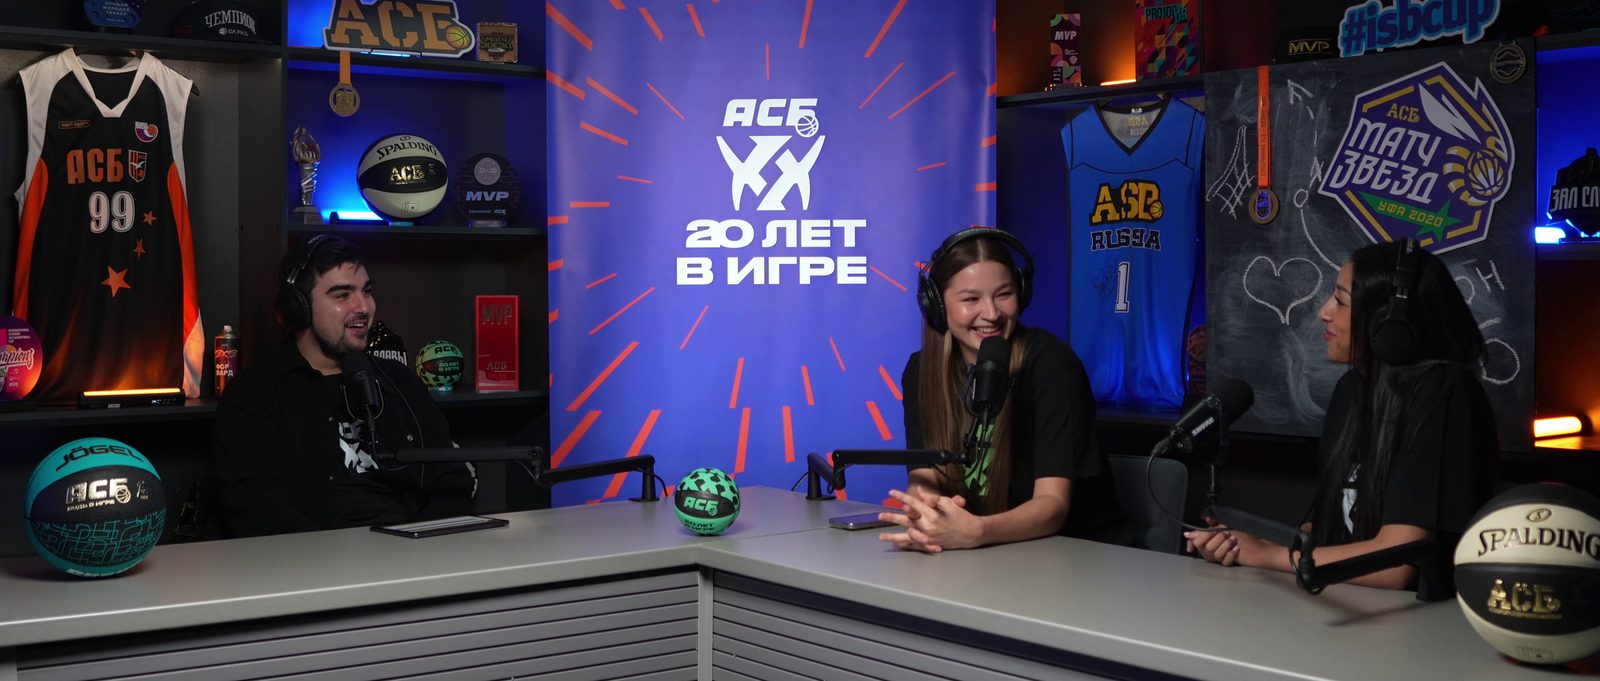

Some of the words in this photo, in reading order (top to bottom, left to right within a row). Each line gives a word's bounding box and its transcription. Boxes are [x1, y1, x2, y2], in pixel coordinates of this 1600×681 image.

[204, 10, 256, 35] ЧЕМПИОН
[1055, 31, 1077, 40] MVP
[1341, 0, 1496, 53] #isbcup
[1288, 40, 1330, 54] MVP
[723, 98, 819, 138] АСБ
[1386, 103, 1421, 123] АСБ
[377, 141, 438, 160] SPALDING
[1348, 118, 1442, 167] МАТЧ
[66, 148, 124, 185] АСБ
[1329, 150, 1439, 204] ЗВЕЗД
[465, 191, 510, 201] MVP
[1091, 181, 1164, 225] ASB
[1550, 186, 1579, 213] ЗАЛ
[1582, 186, 1600, 208] СЛ
[88, 190, 135, 234] 99
[1377, 200, 1405, 217] УФА
[1409, 208, 1444, 228] 2020
[685, 219, 755, 248] 20
[761, 219, 867, 248] ЛЕТ
[676, 256, 714, 285] В
[727, 256, 867, 285] ИГРЕ
[1115, 261, 1131, 314] 1
[482, 304, 513, 325] MVP
[1191, 416, 1215, 437] SHURE
[55, 444, 144, 472] JÖGEL
[65, 477, 131, 504] АСБ
[684, 496, 719, 516] АСБ
[1477, 527, 1600, 562] SPALDING
[1486, 578, 1563, 613] АСБ
